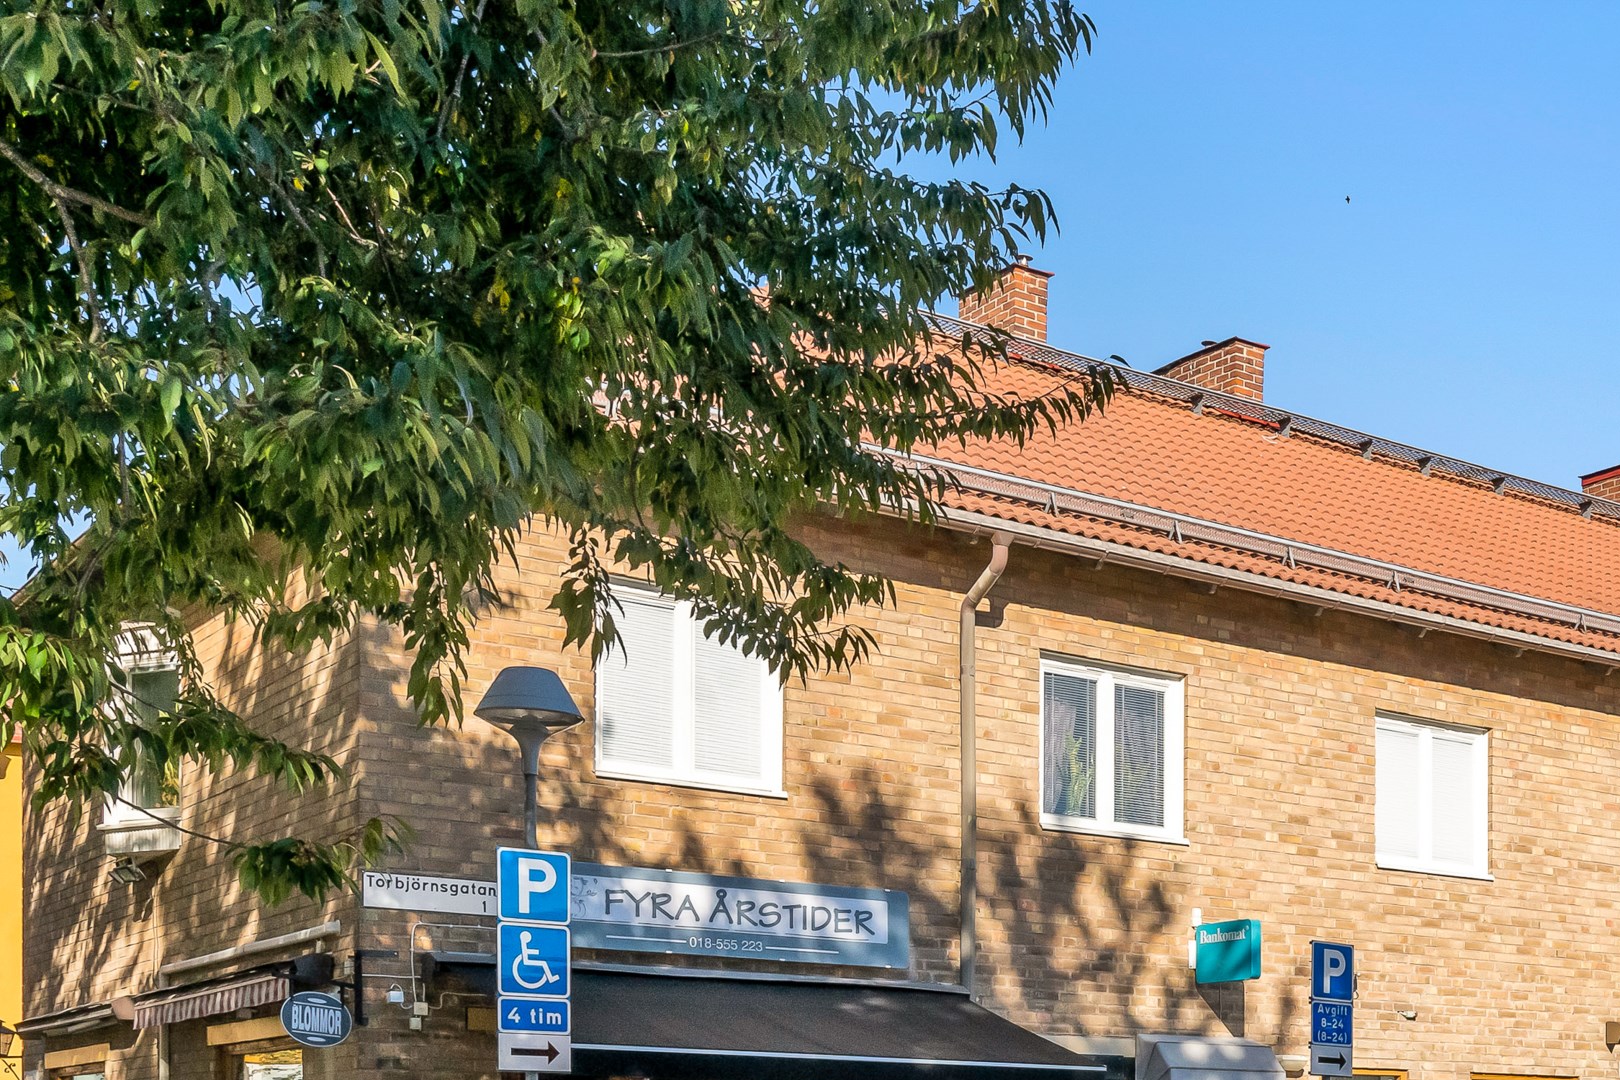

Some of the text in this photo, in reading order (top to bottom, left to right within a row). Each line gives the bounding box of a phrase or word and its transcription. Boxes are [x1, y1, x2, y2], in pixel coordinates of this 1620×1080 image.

[366, 874, 497, 897] Torbjörnsgatan
[518, 857, 557, 914] P
[482, 900, 487, 913] 1
[605, 888, 876, 936] FYRA ÅRSTIDER
[689, 935, 764, 952] 018-555 223
[1200, 927, 1246, 944] Bankomat
[1323, 948, 1346, 994] P
[507, 1006, 562, 1025] 4 tim
[1317, 1003, 1348, 1017] Avgift
[291, 1004, 342, 1035] BLOMMOR
[1320, 1017, 1344, 1029] 8-24
[1317, 1030, 1348, 1043] (8-24)
